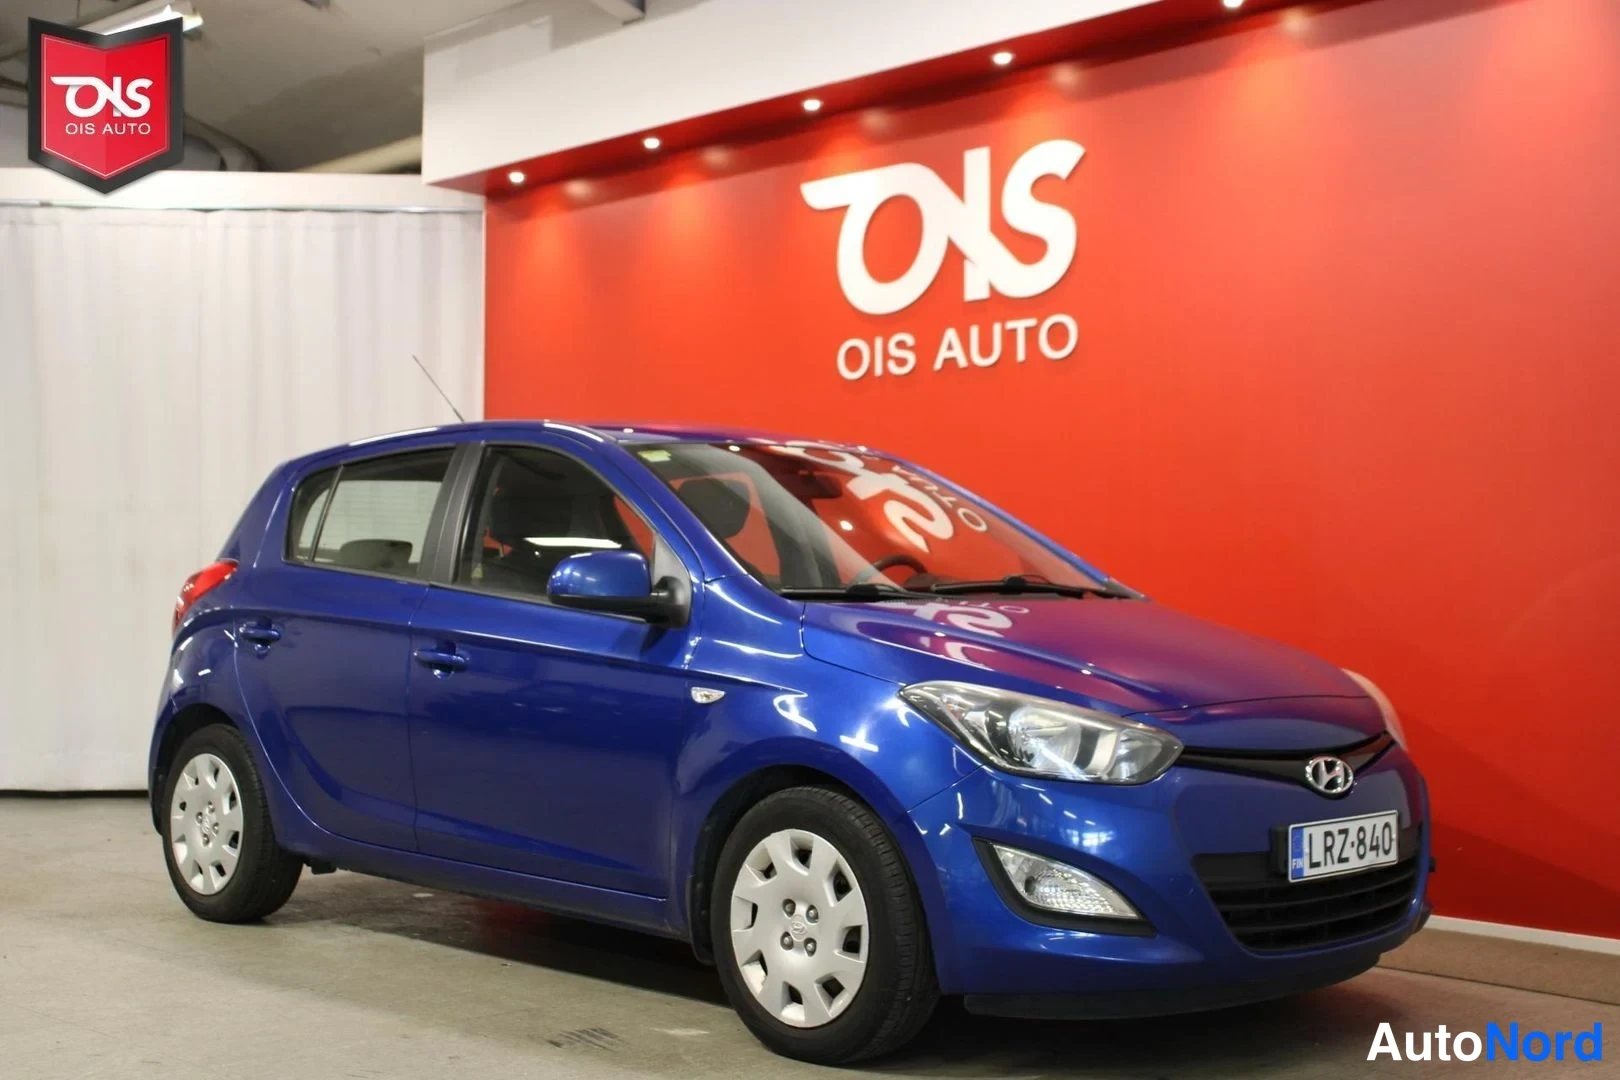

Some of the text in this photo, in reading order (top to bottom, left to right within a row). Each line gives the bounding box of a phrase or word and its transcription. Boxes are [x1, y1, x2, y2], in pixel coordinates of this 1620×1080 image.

[800, 139, 1086, 314] OIS
[836, 313, 1079, 380] OIS AUTO
